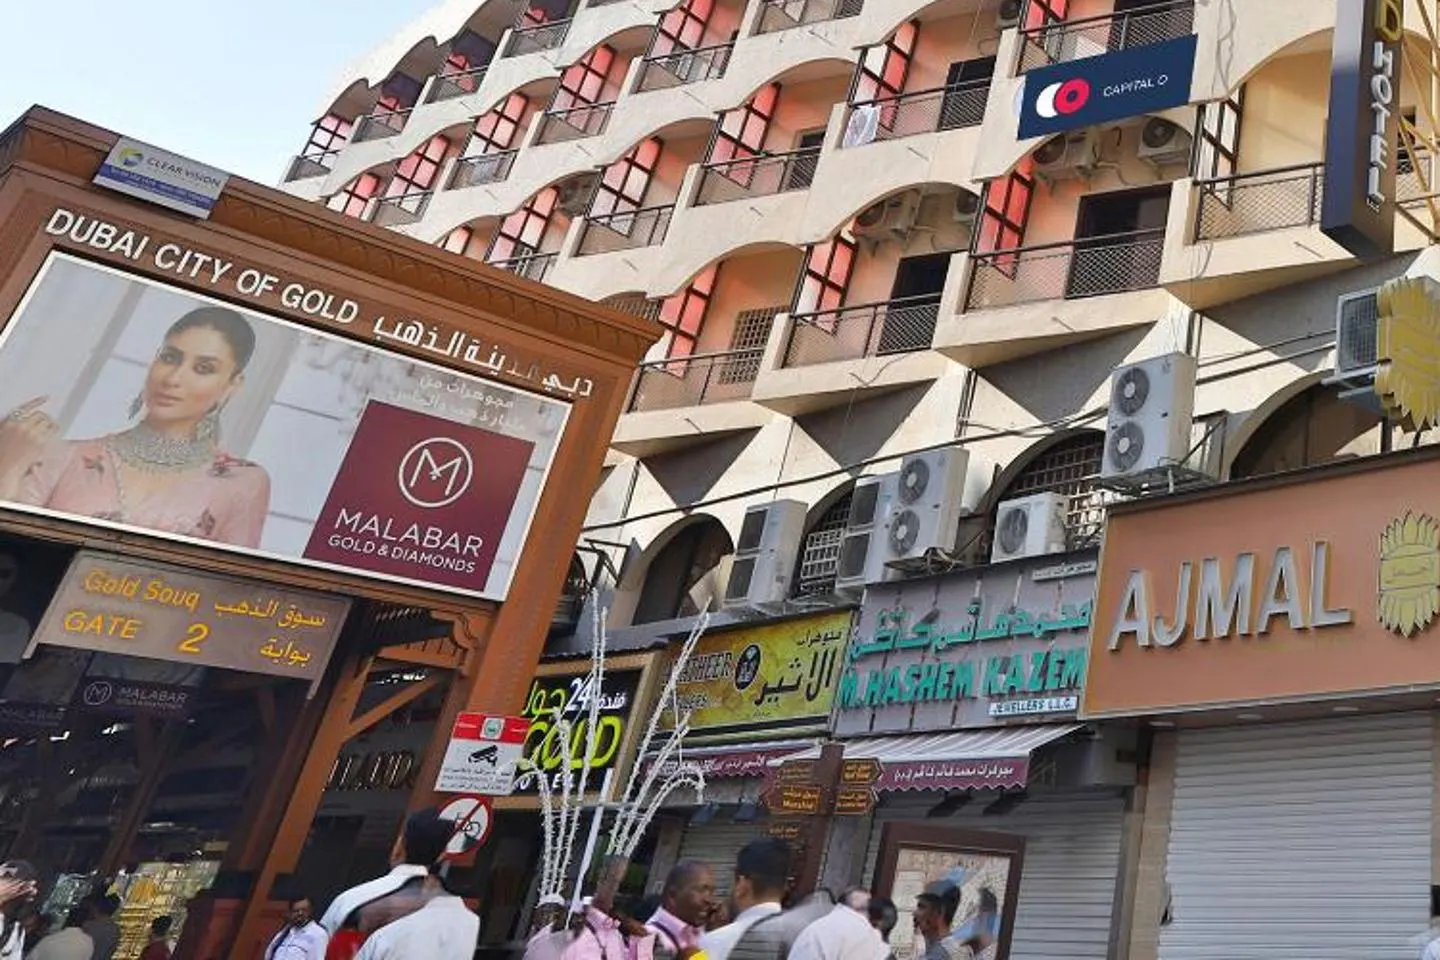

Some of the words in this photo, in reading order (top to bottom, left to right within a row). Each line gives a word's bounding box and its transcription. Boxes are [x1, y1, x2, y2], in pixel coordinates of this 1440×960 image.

[1103, 78, 1154, 98] CAPITAL
[1157, 74, 1168, 86] O
[1368, 42, 1394, 203] HOTEL
[147, 157, 183, 174] CLEAR
[184, 169, 219, 187] VISION
[45, 208, 150, 260] DUBAI
[154, 243, 234, 285] CITY
[236, 268, 279, 298] OF
[281, 283, 359, 325] GOLD
[373, 316, 465, 359] الذهب
[542, 373, 593, 398] دبي
[334, 508, 483, 558] MALABAR
[328, 535, 376, 555] GOLD
[378, 543, 389, 558] &
[391, 546, 476, 574] DIAMONDS
[83, 568, 141, 598] Gold
[143, 579, 200, 612] Souq
[213, 596, 279, 619] الذهب
[1106, 540, 1354, 652] AJMAL
[64, 610, 142, 640] GATE
[178, 622, 212, 654] 2
[277, 603, 326, 628] سوق
[259, 635, 313, 668] بوابة
[981, 647, 1087, 697] KAZEM
[117, 687, 189, 704] MALABAR
